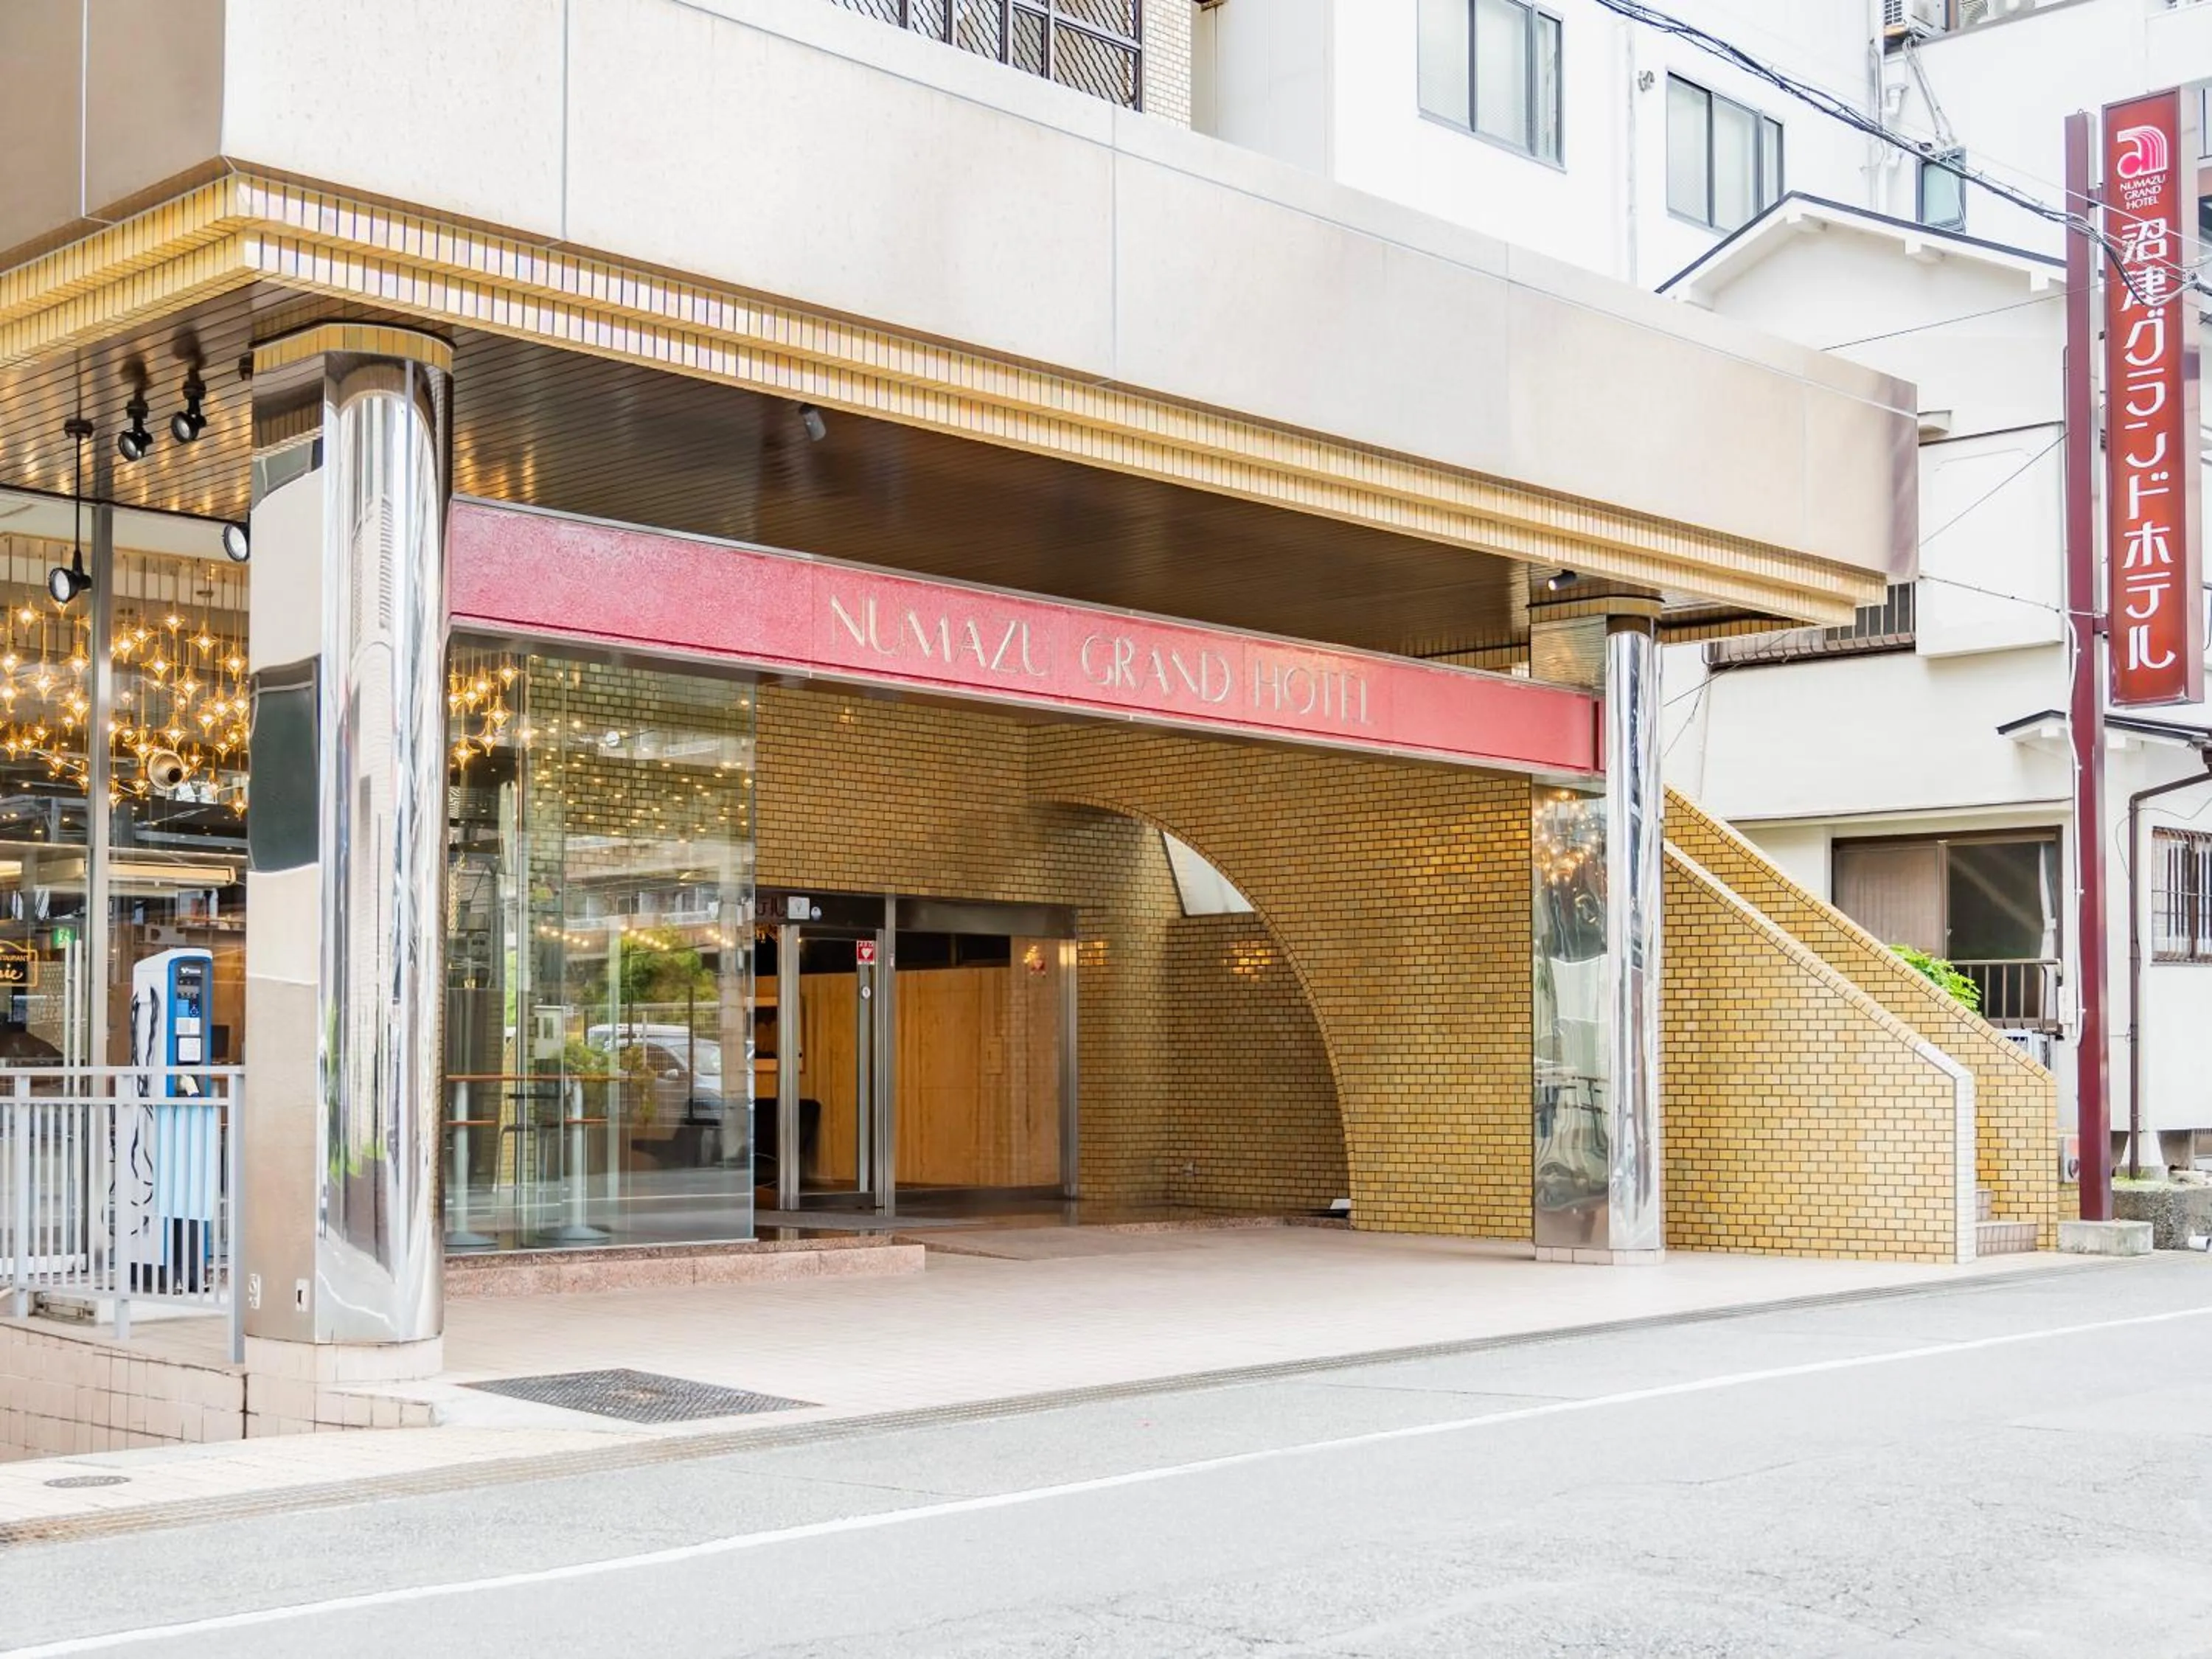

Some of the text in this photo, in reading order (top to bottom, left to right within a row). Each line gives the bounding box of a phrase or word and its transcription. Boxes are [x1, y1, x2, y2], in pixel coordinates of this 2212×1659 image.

[2120, 173, 2166, 192] NUMAZU
[2124, 184, 2162, 201] GRAND
[2126, 195, 2160, 210] HOTEL
[2120, 218, 2176, 671] 沼津グランドホテル
[830, 594, 1372, 725] NUMAZU GRAND HOTEL
